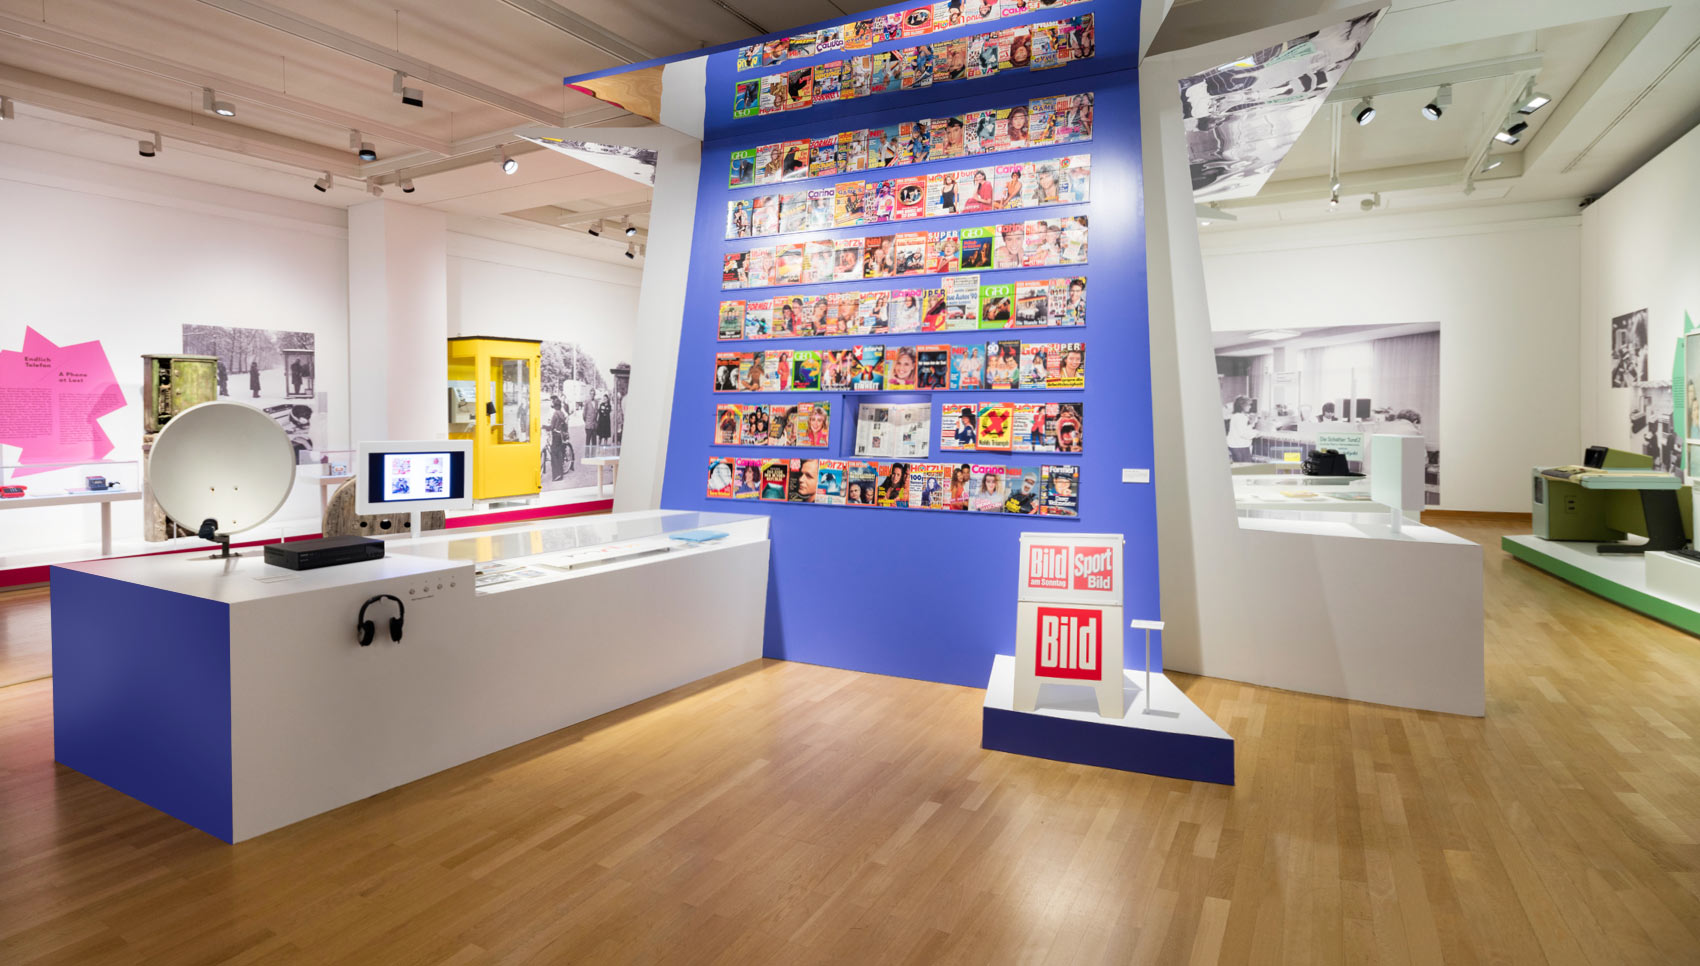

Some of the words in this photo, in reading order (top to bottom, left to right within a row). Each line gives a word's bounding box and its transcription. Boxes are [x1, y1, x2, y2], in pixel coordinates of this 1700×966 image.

[808, 189, 834, 199] Carina
[962, 228, 983, 238] GEO
[985, 286, 1009, 296] GEO
[795, 352, 812, 360] GEO
[971, 464, 1004, 474] Carina
[1031, 548, 1067, 579] Bild
[1074, 549, 1112, 579] Sport
[1041, 578, 1066, 588] Sonntag
[1088, 576, 1111, 589] Bild
[1041, 615, 1097, 670] Bild
